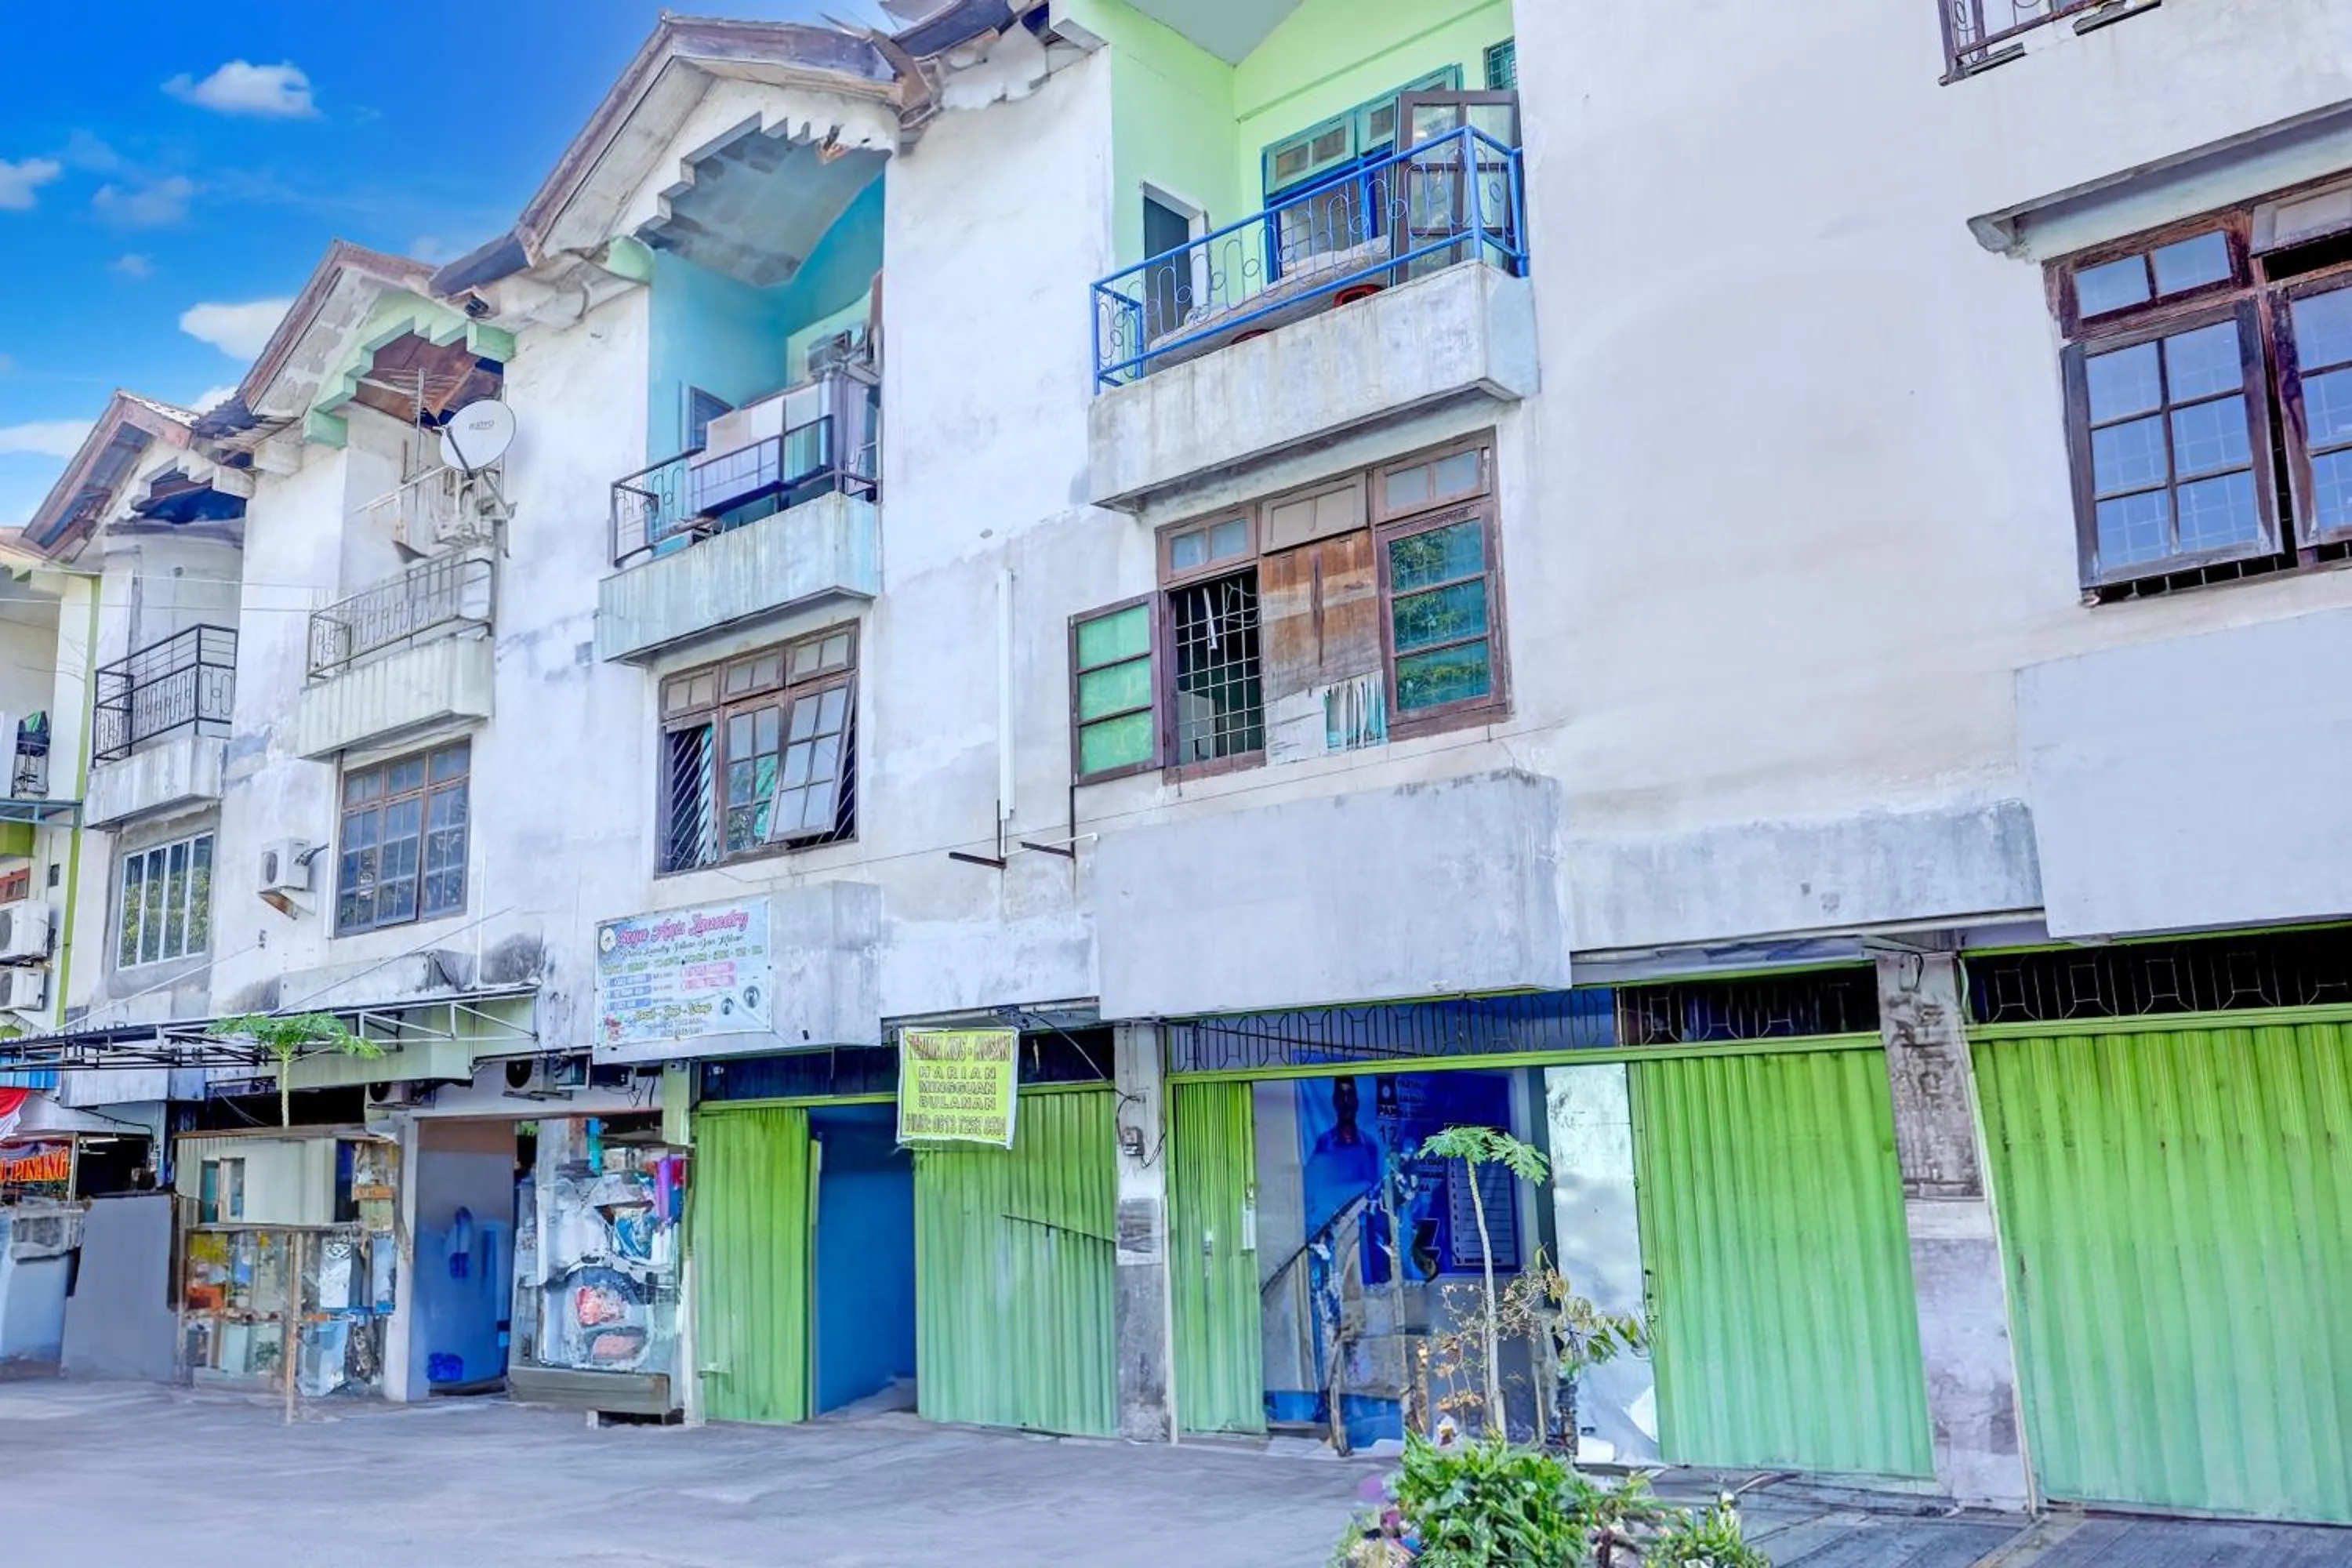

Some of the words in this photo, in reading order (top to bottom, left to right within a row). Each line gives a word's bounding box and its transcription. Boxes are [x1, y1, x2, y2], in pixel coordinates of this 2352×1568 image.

[688, 909, 749, 938] Laundry
[918, 1065, 996, 1080] HARIAN
[918, 1080, 996, 1095] MINGGUAN
[918, 1095, 996, 1111] BULANAN
[12, 1146, 68, 1181] PINANG
